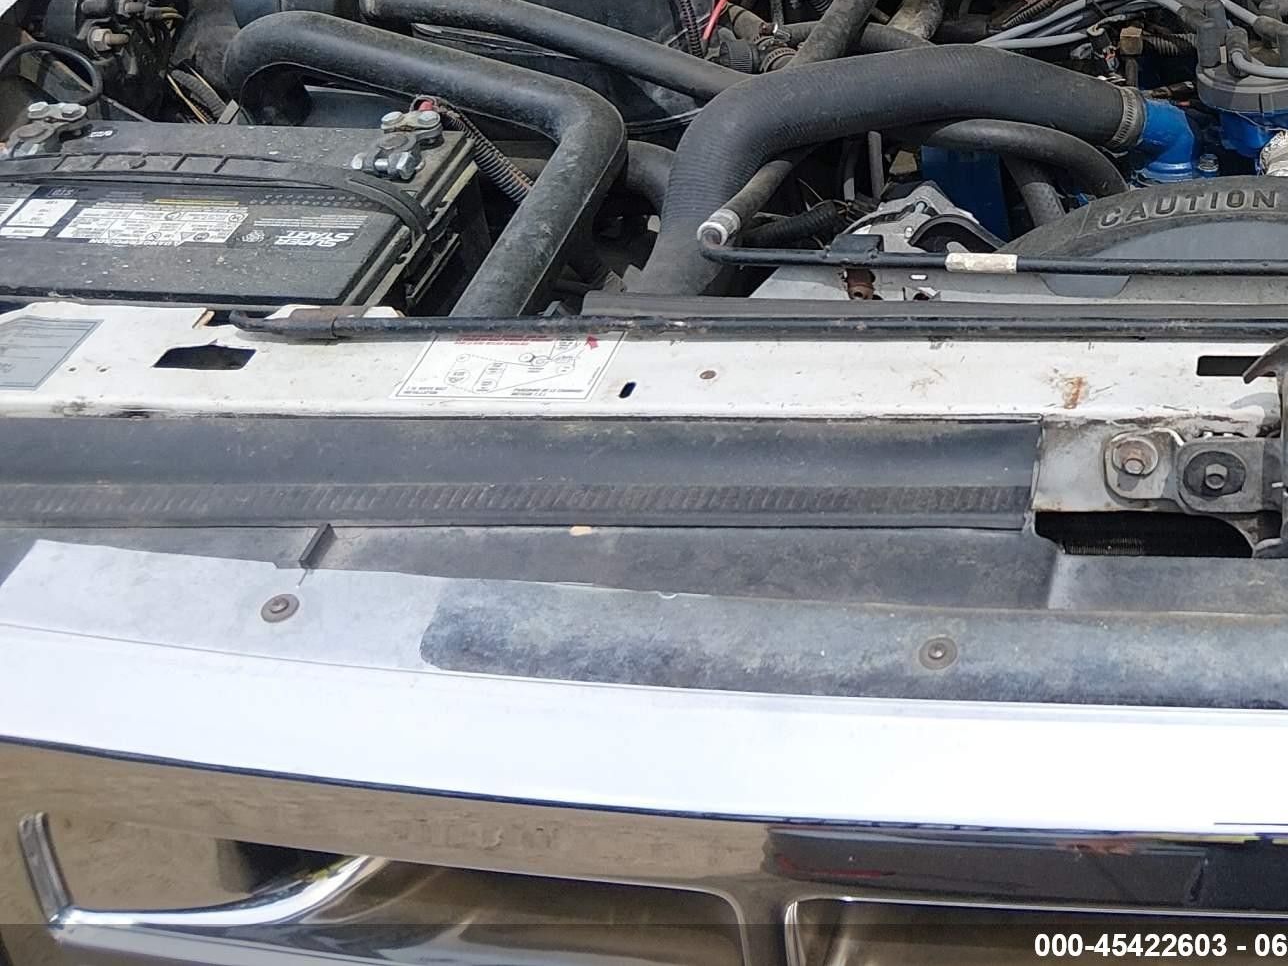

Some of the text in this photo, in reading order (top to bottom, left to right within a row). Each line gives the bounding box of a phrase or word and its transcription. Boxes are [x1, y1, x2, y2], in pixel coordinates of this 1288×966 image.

[1099, 189, 1278, 227] CAUTION
[273, 236, 338, 248] SUPER
[285, 230, 355, 242] START
